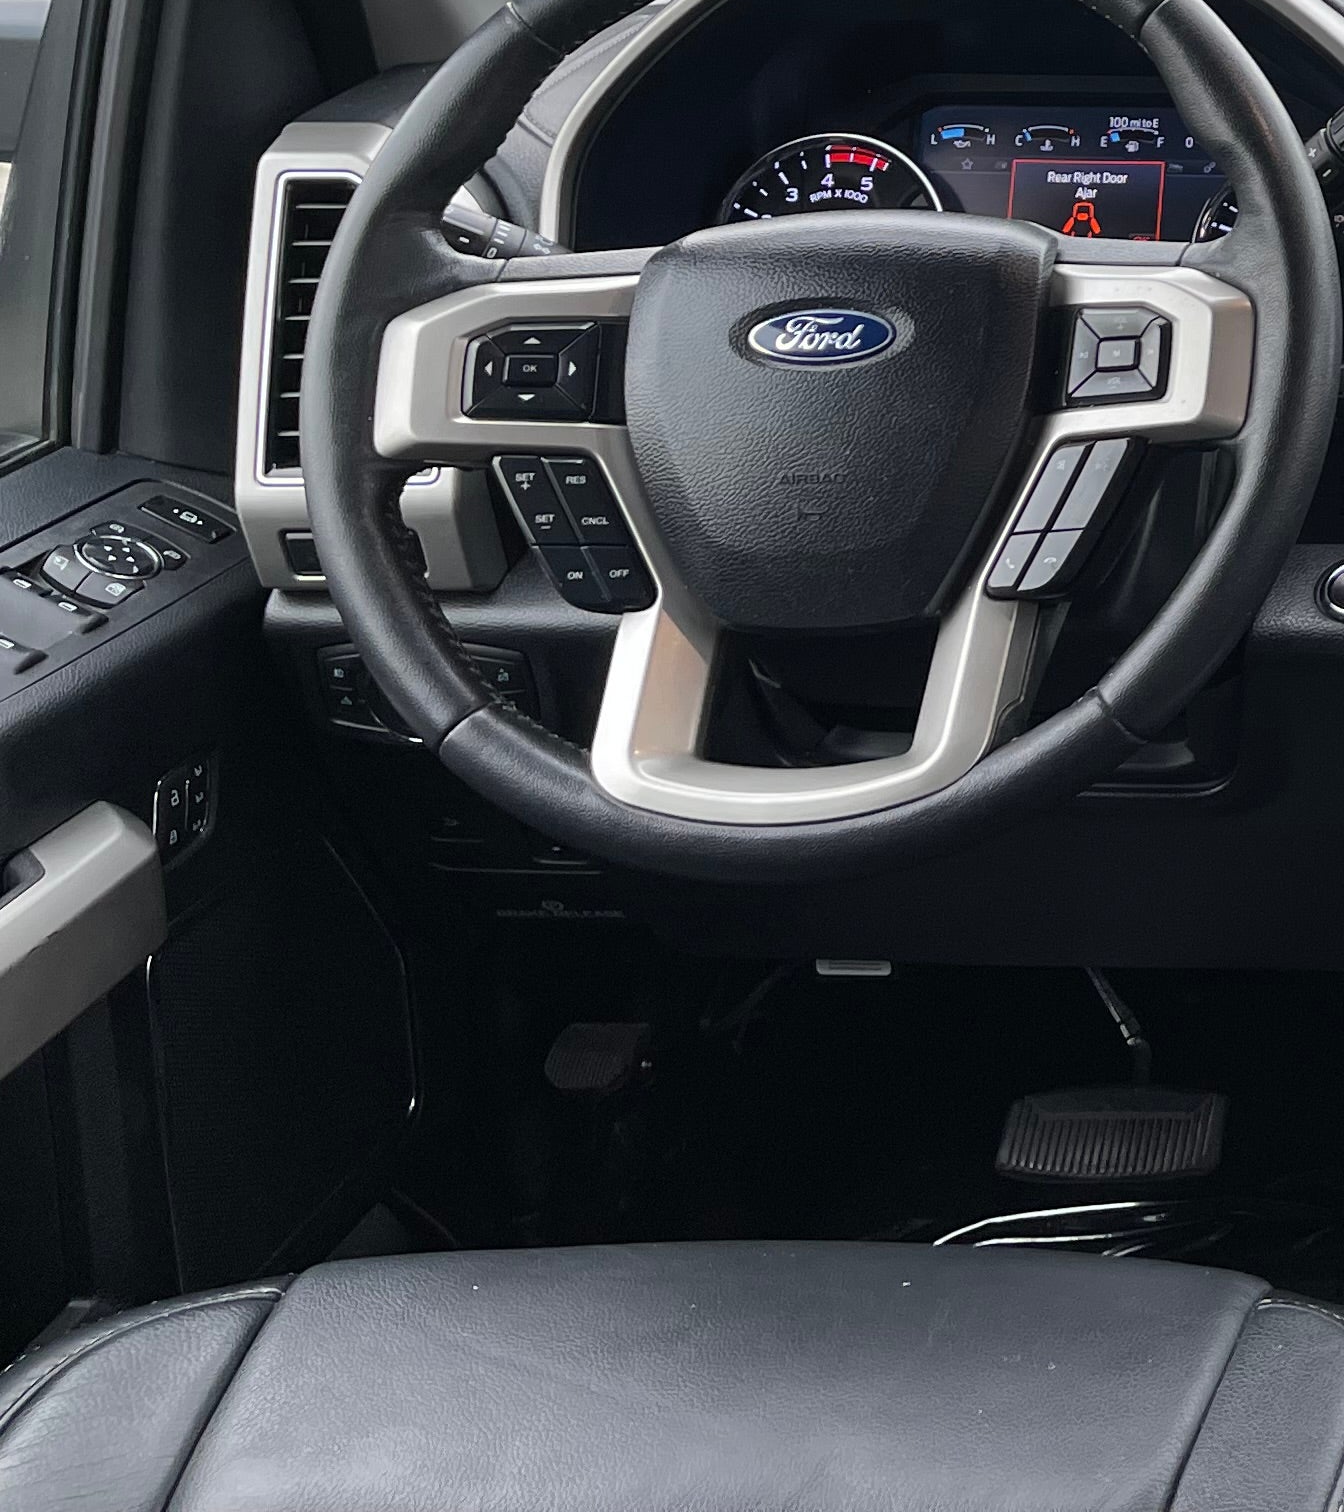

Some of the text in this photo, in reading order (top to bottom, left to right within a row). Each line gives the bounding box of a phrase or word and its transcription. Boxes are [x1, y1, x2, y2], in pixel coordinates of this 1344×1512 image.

[1109, 116, 1129, 129] 100
[1130, 117, 1142, 129] mi
[930, 134, 938, 145] L
[986, 134, 996, 146] H
[1015, 135, 1023, 147] C
[1071, 136, 1081, 148] H
[1100, 136, 1108, 148] E
[1157, 137, 1165, 149] F
[820, 173, 835, 187] 4
[860, 176, 873, 191] 5
[1047, 171, 1128, 186] Rear Right Door
[785, 188, 799, 202] 3
[809, 189, 832, 204] RPM
[844, 190, 869, 204] 1000
[1075, 187, 1097, 201] Ajar
[775, 315, 865, 351] Ford
[522, 364, 538, 373] OK
[515, 472, 535, 482] SET
[565, 475, 586, 485] RES
[534, 513, 555, 523] SET
[581, 516, 609, 526] CNCL
[567, 571, 584, 580] ON
[609, 569, 630, 579] OFF
